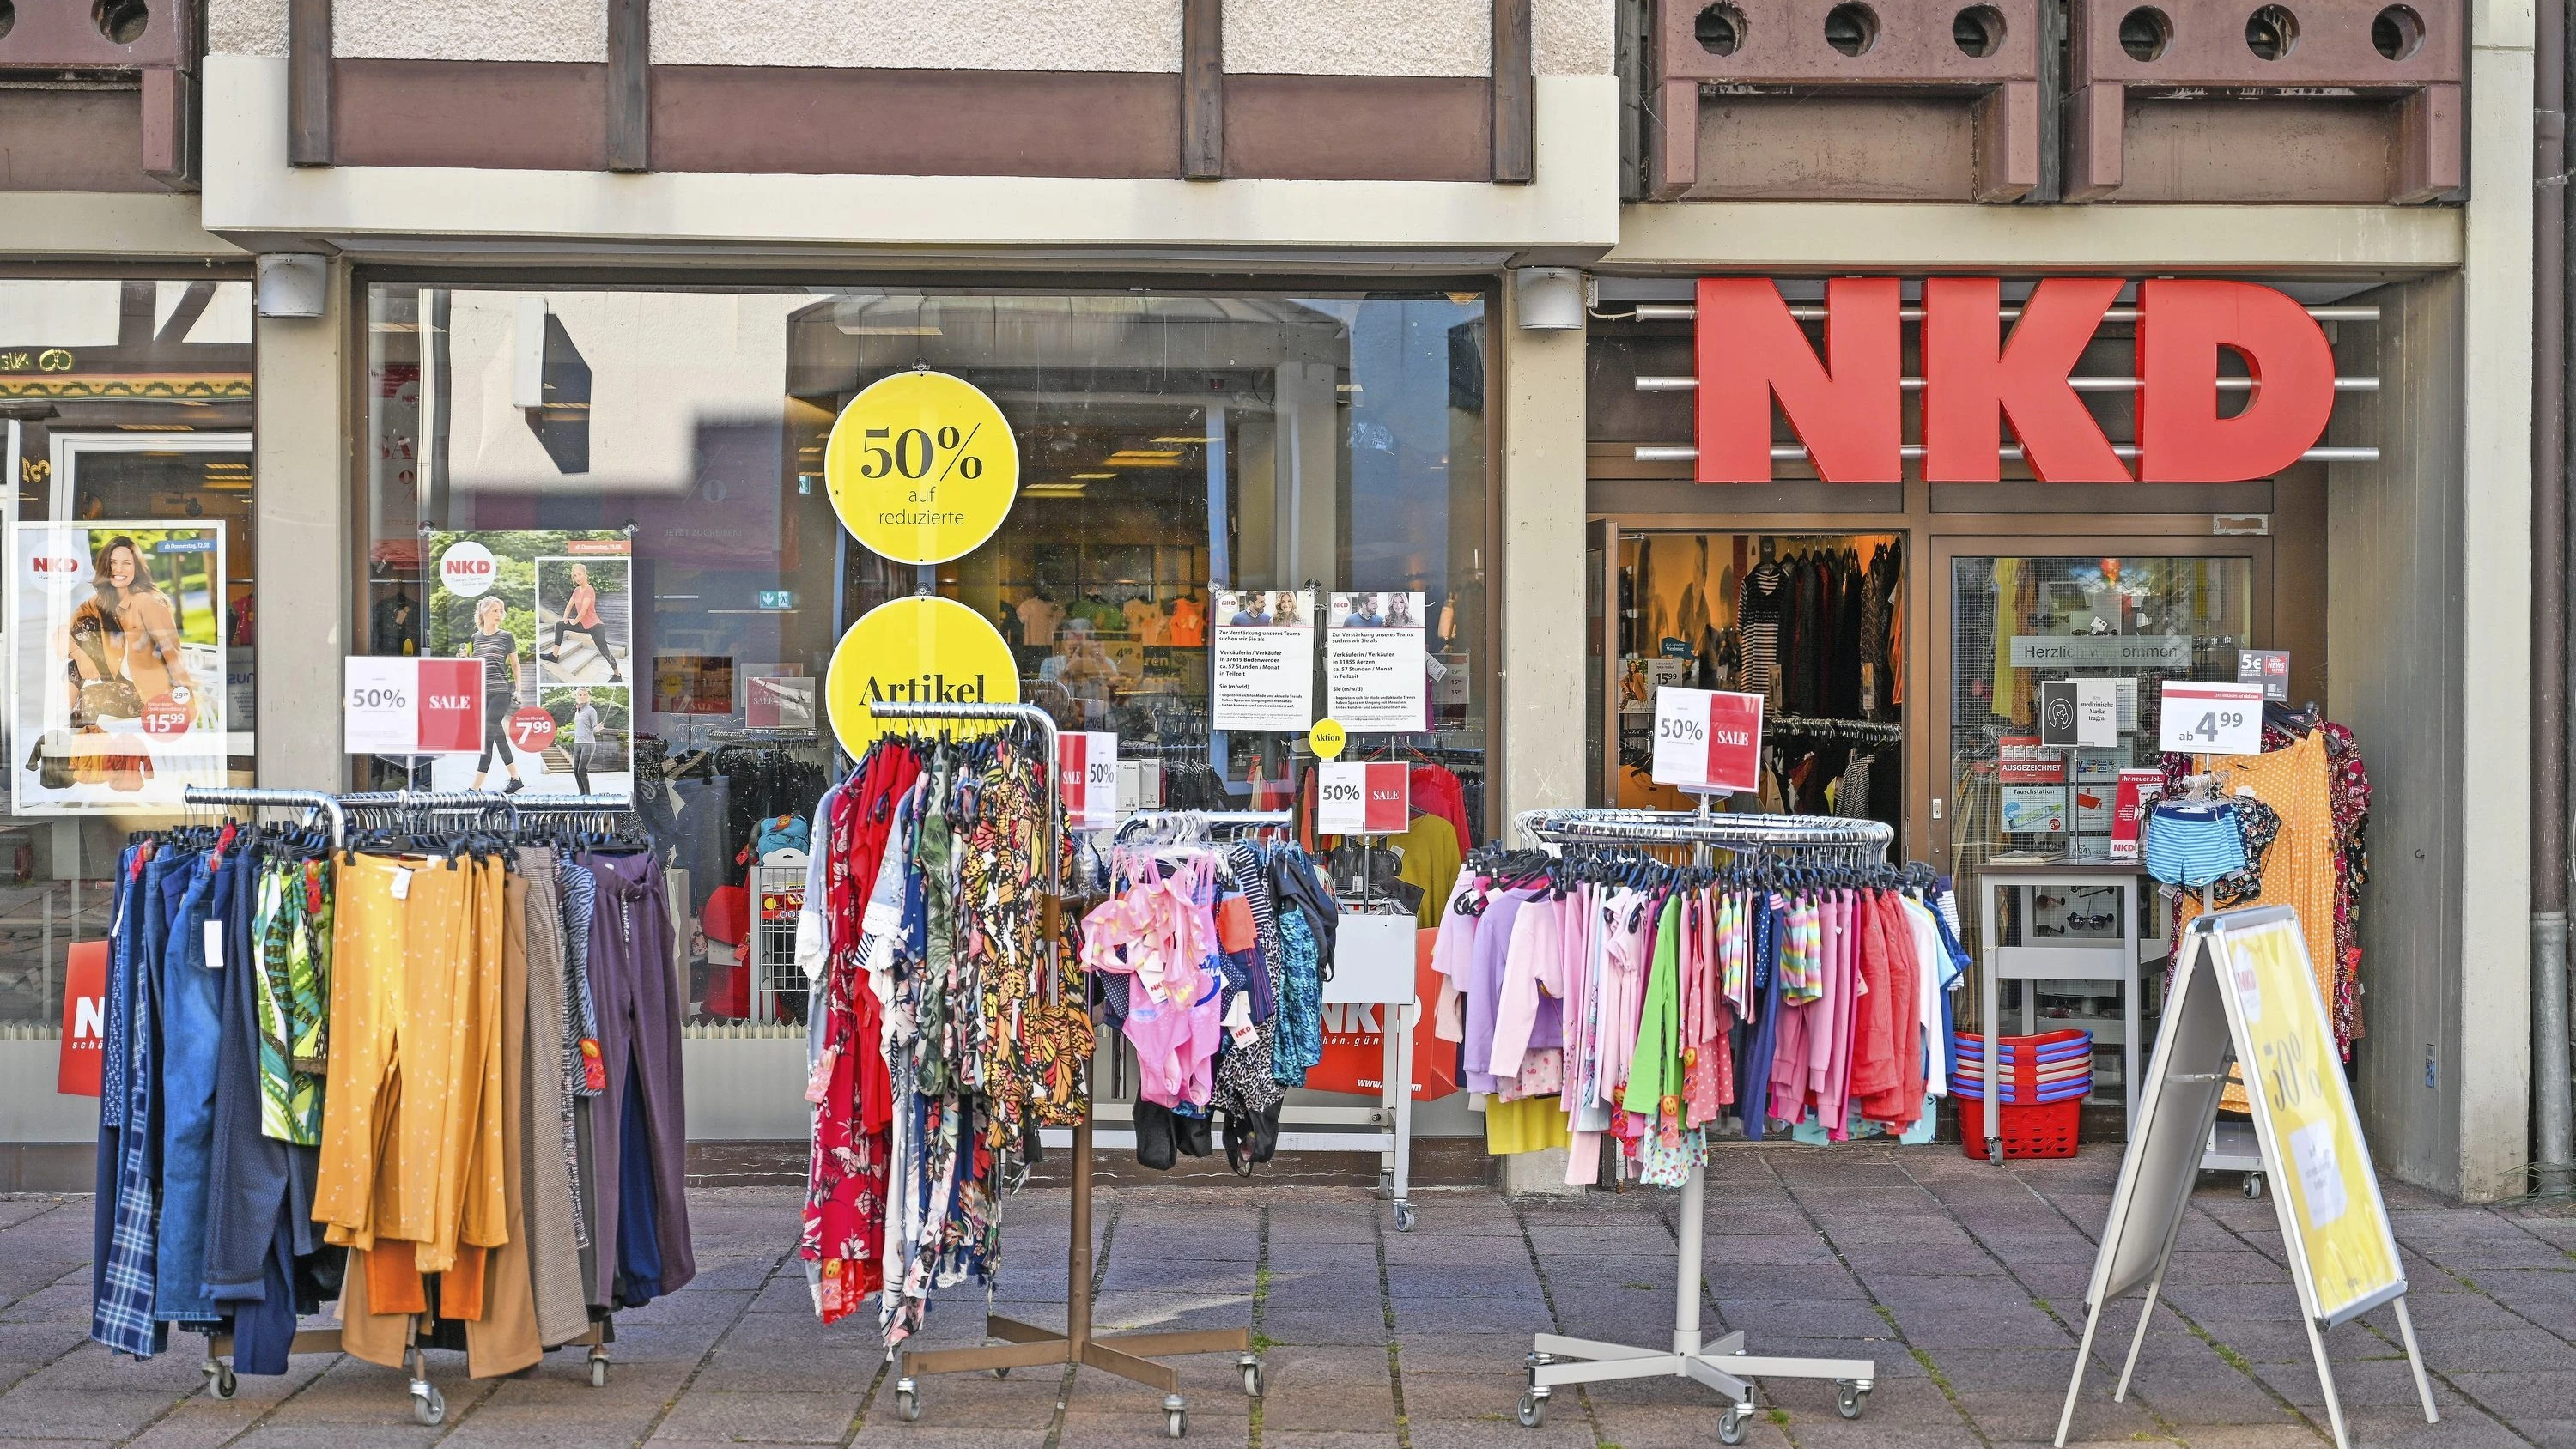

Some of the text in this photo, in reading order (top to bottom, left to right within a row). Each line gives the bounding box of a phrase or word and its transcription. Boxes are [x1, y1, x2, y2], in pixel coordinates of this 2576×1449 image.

[1694, 278, 2336, 482] NKD
[860, 422, 982, 481] 50%
[908, 487, 936, 503] auf
[878, 508, 964, 525] reduzierte
[33, 557, 78, 572] NKD
[446, 560, 490, 574] NKD
[2241, 653, 2262, 670] 5€
[1656, 673, 1678, 685] 1599
[352, 689, 470, 709] 50% SALE
[859, 674, 986, 706] Artikel
[147, 713, 185, 732] 1599
[2178, 712, 2243, 742] ab 499
[516, 721, 551, 744] 799
[1315, 733, 1340, 742] Aktion
[1661, 718, 1749, 746] 50% SALE
[1063, 763, 1114, 785] SALE 50%
[1323, 785, 1400, 800] 50% SALE
[1235, 1026, 1252, 1038] NKD
